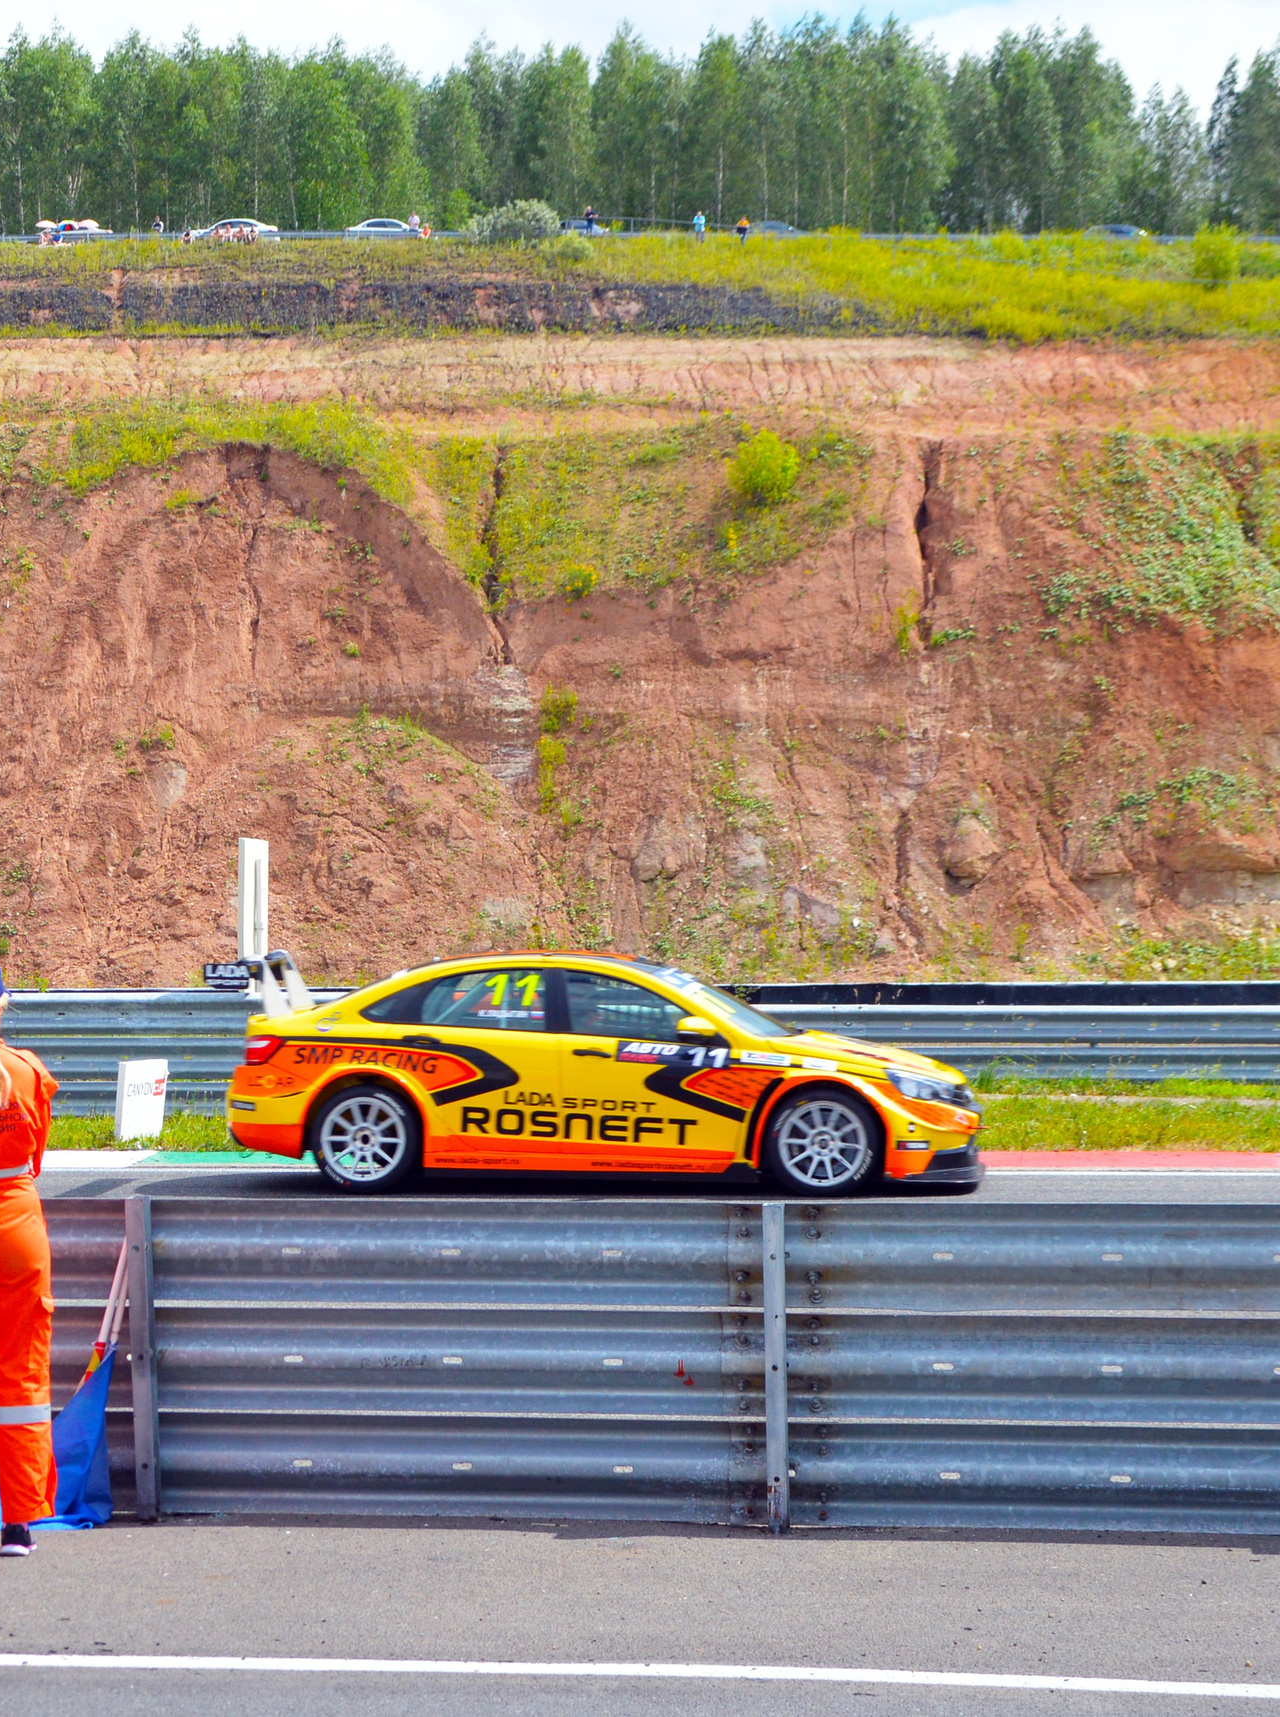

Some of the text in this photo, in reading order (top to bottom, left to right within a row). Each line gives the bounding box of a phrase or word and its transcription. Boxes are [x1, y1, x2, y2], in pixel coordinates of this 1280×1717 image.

[205, 965, 250, 978] LADA
[485, 973, 540, 1007] 11
[294, 1047, 438, 1074] SMP RACING
[686, 1046, 729, 1069] 11
[504, 1090, 657, 1113] LADA SPORT
[461, 1105, 698, 1146] ROSNEFT
